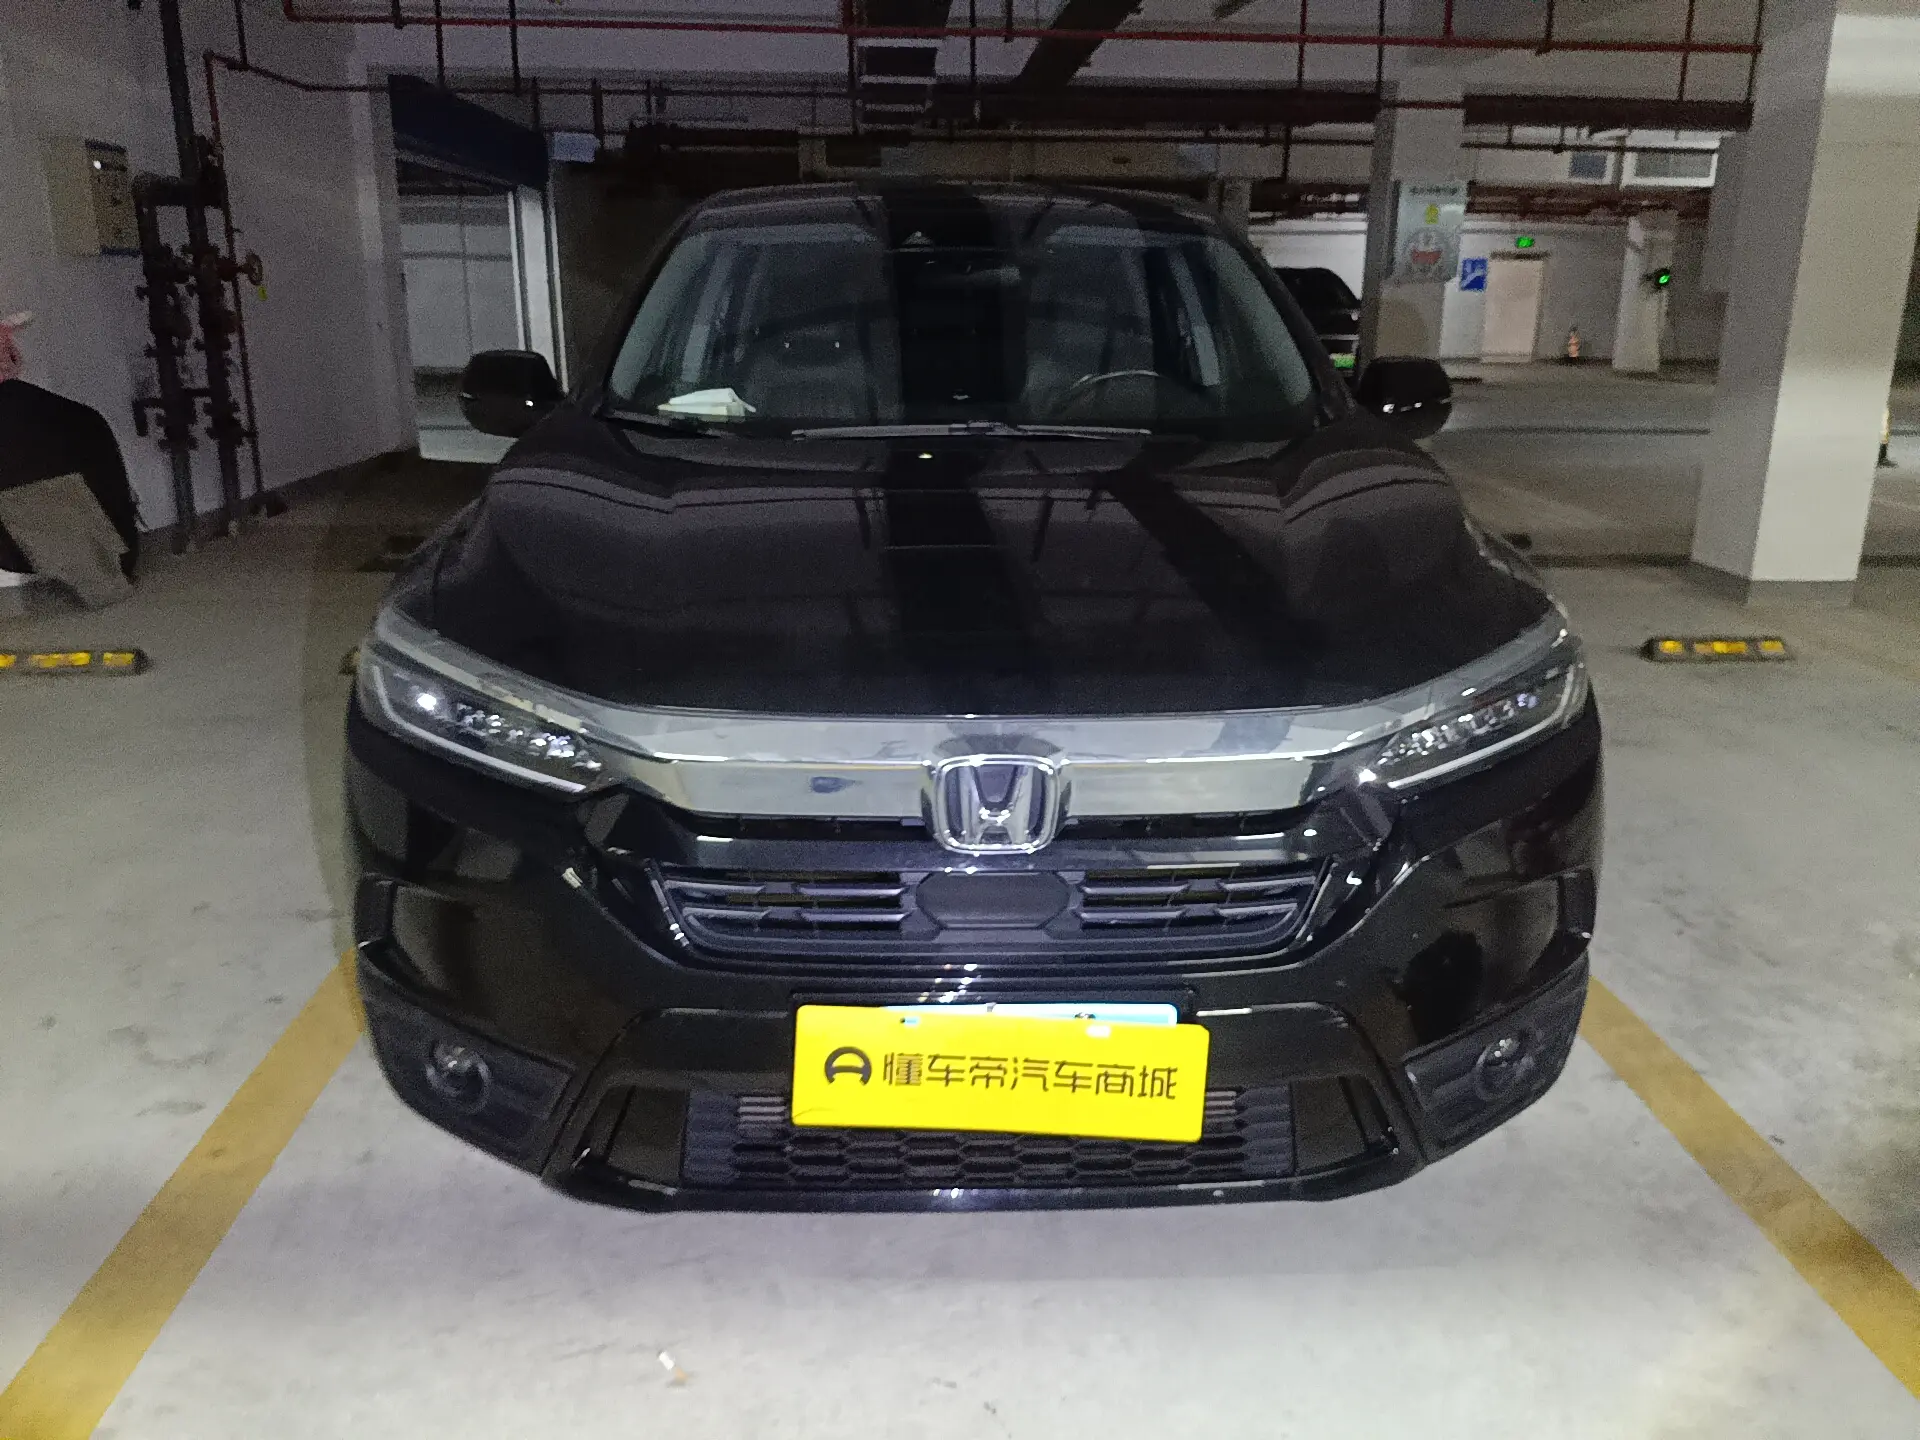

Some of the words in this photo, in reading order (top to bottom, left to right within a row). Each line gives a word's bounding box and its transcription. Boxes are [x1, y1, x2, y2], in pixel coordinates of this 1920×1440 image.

[882, 1051, 1178, 1100] 懂车帝汽车商城
